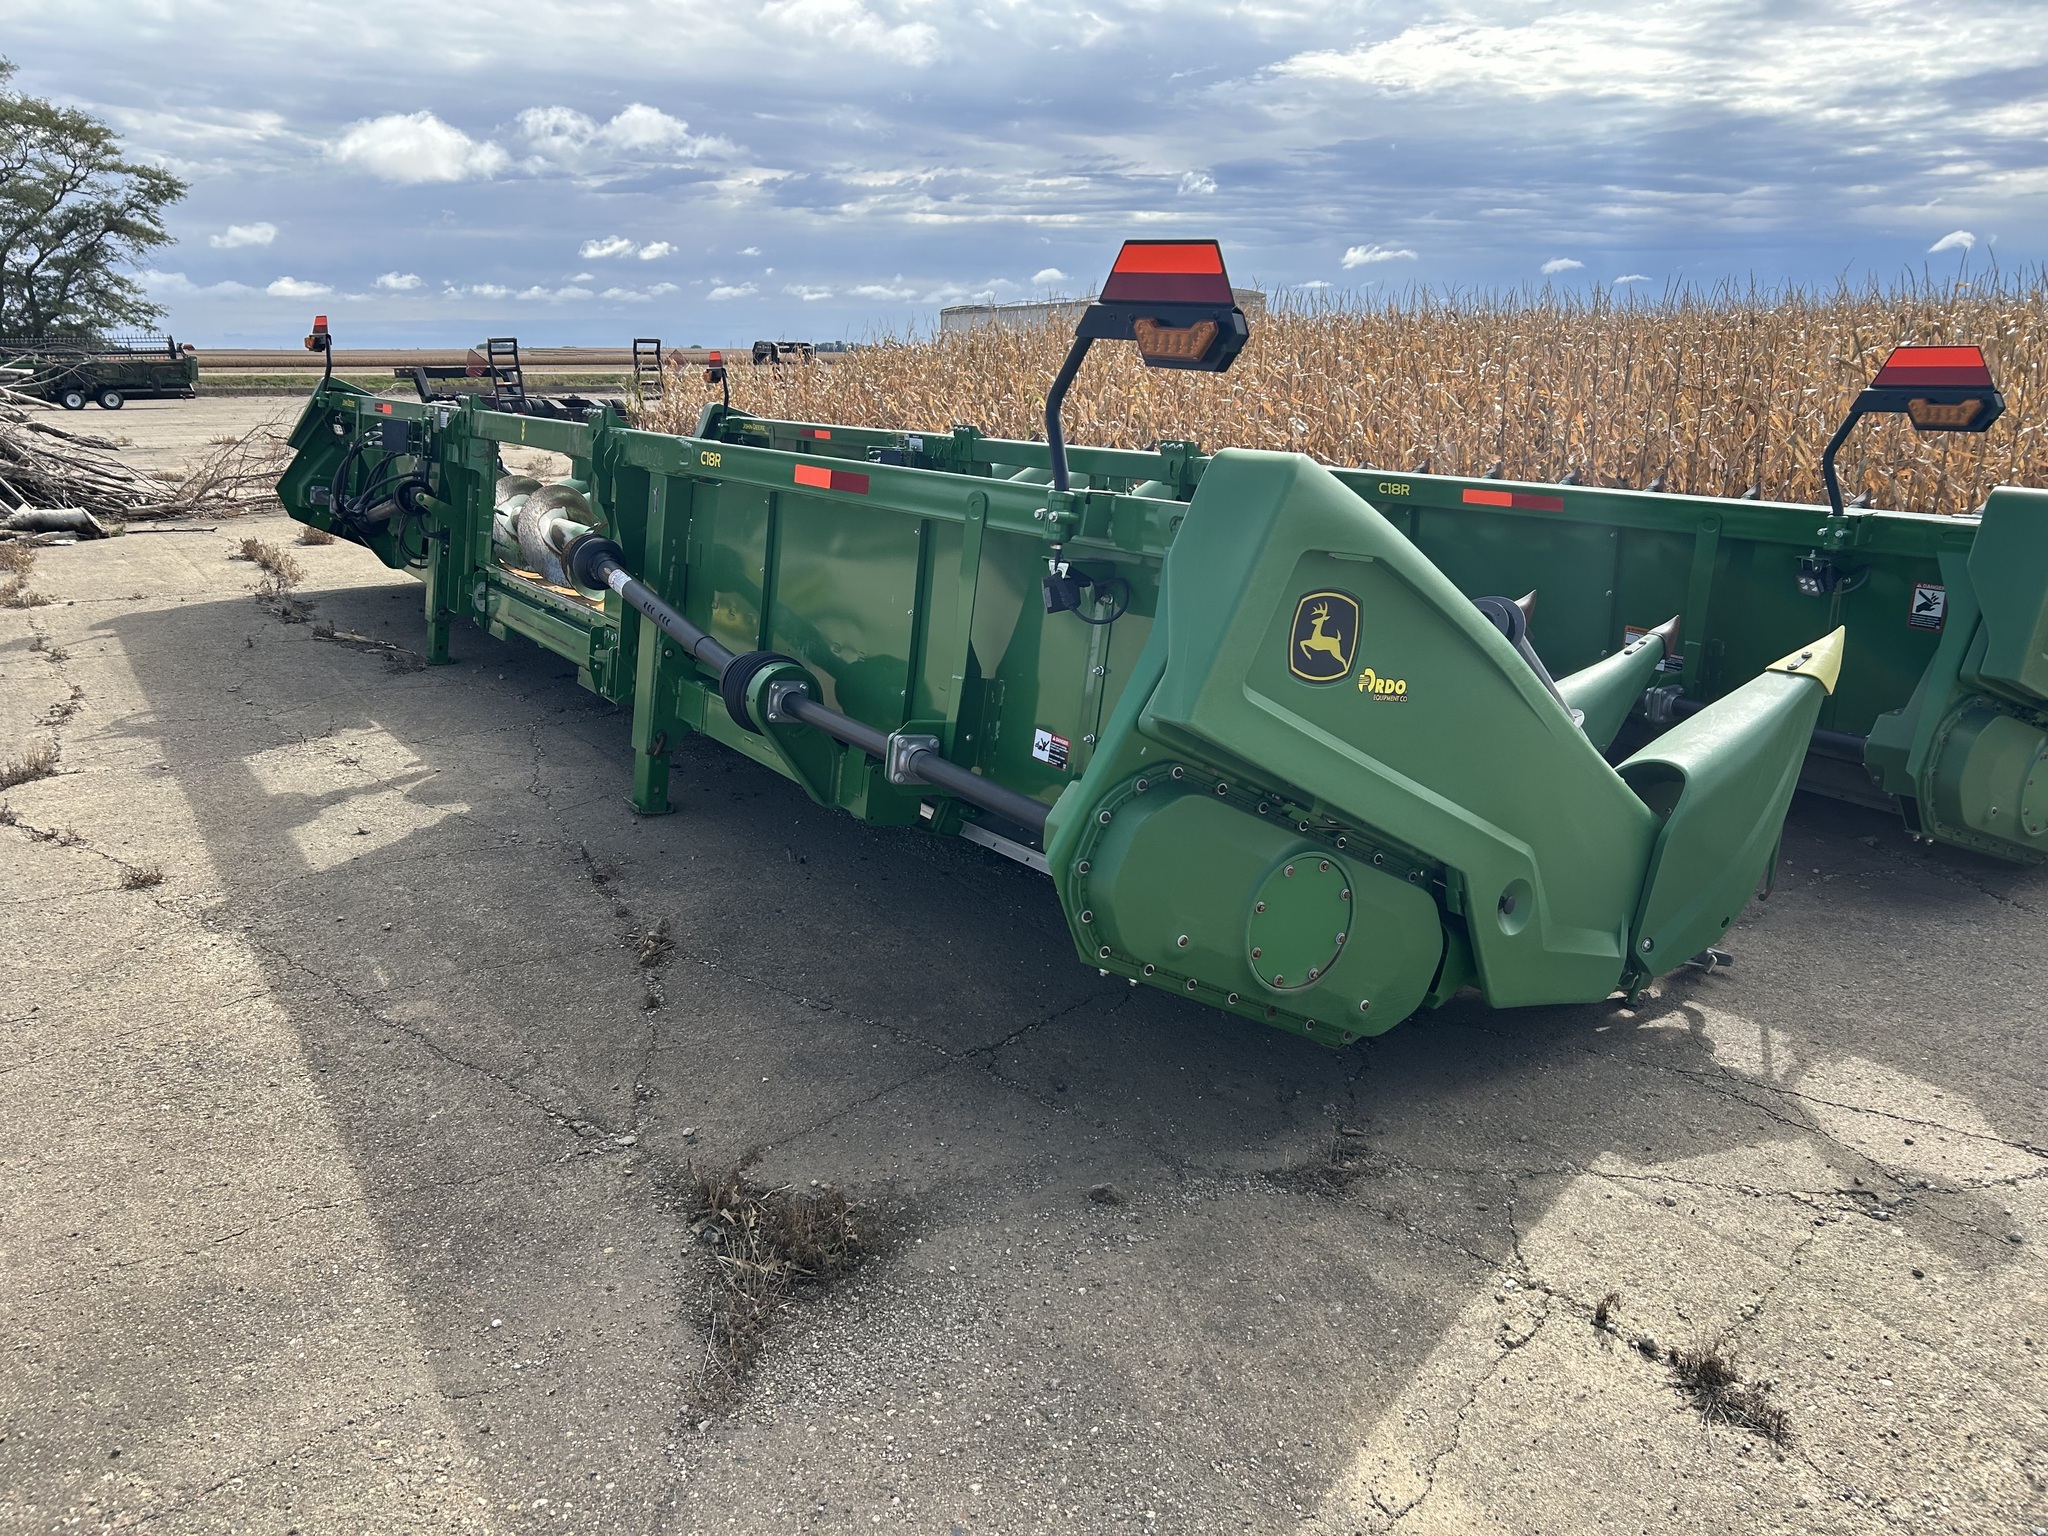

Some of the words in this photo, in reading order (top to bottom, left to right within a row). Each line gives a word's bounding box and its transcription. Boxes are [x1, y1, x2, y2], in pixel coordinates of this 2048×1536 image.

[700, 451, 721, 468] C18R
[1378, 482, 1411, 496] C18R
[1373, 694, 1399, 702] EQUIPMENT
